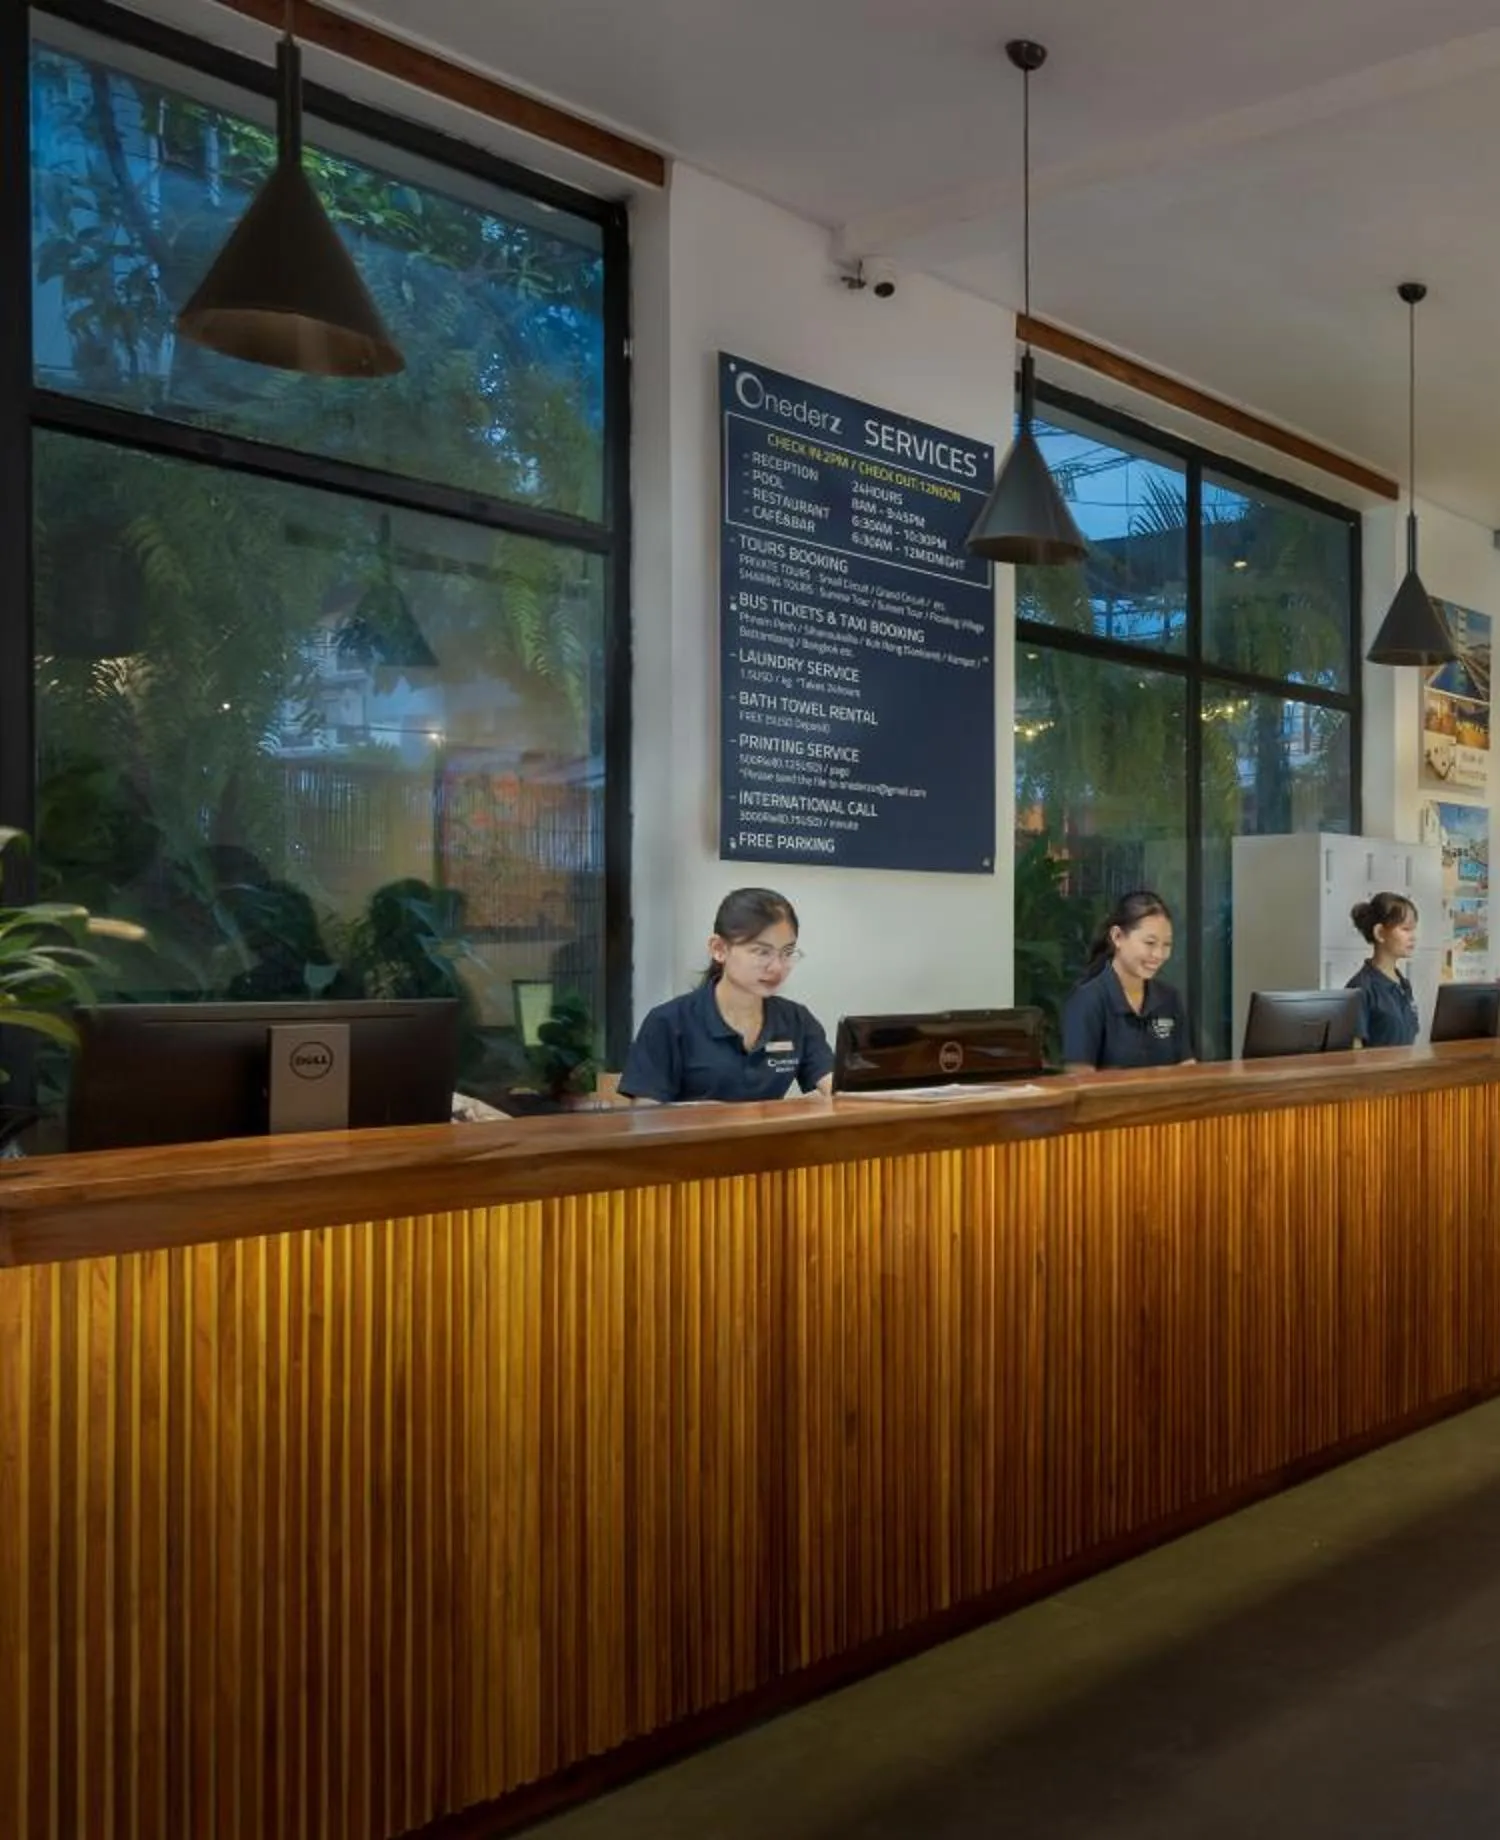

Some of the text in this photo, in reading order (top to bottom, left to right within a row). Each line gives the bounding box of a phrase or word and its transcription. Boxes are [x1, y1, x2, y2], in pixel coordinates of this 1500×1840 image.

[735, 370, 977, 478] Onederz SERVICES
[767, 433, 806, 456] CHECK
[859, 461, 896, 483] CHECK
[751, 451, 903, 505] RECEPTION 24HOURS
[752, 469, 784, 489] POOL
[851, 497, 876, 514] 8AM
[752, 487, 830, 519] RESTAURANT
[851, 514, 892, 535] 6:30AM
[903, 528, 947, 550] 10:30PM
[739, 534, 848, 573] TOURS BOOKING
[851, 530, 892, 552] 6:30AM
[739, 592, 925, 642] BUS TICKETS & TAXI BOOKING
[739, 647, 860, 682] LAUNDRY SERVICE
[739, 691, 878, 725] BATH TOWEL RENTAL
[739, 734, 860, 762] PRINTING SERVICE
[739, 790, 878, 817] INTERNATIONAL CALL
[739, 832, 835, 851] FREE PARKING
[295, 1055, 328, 1067] DELL
